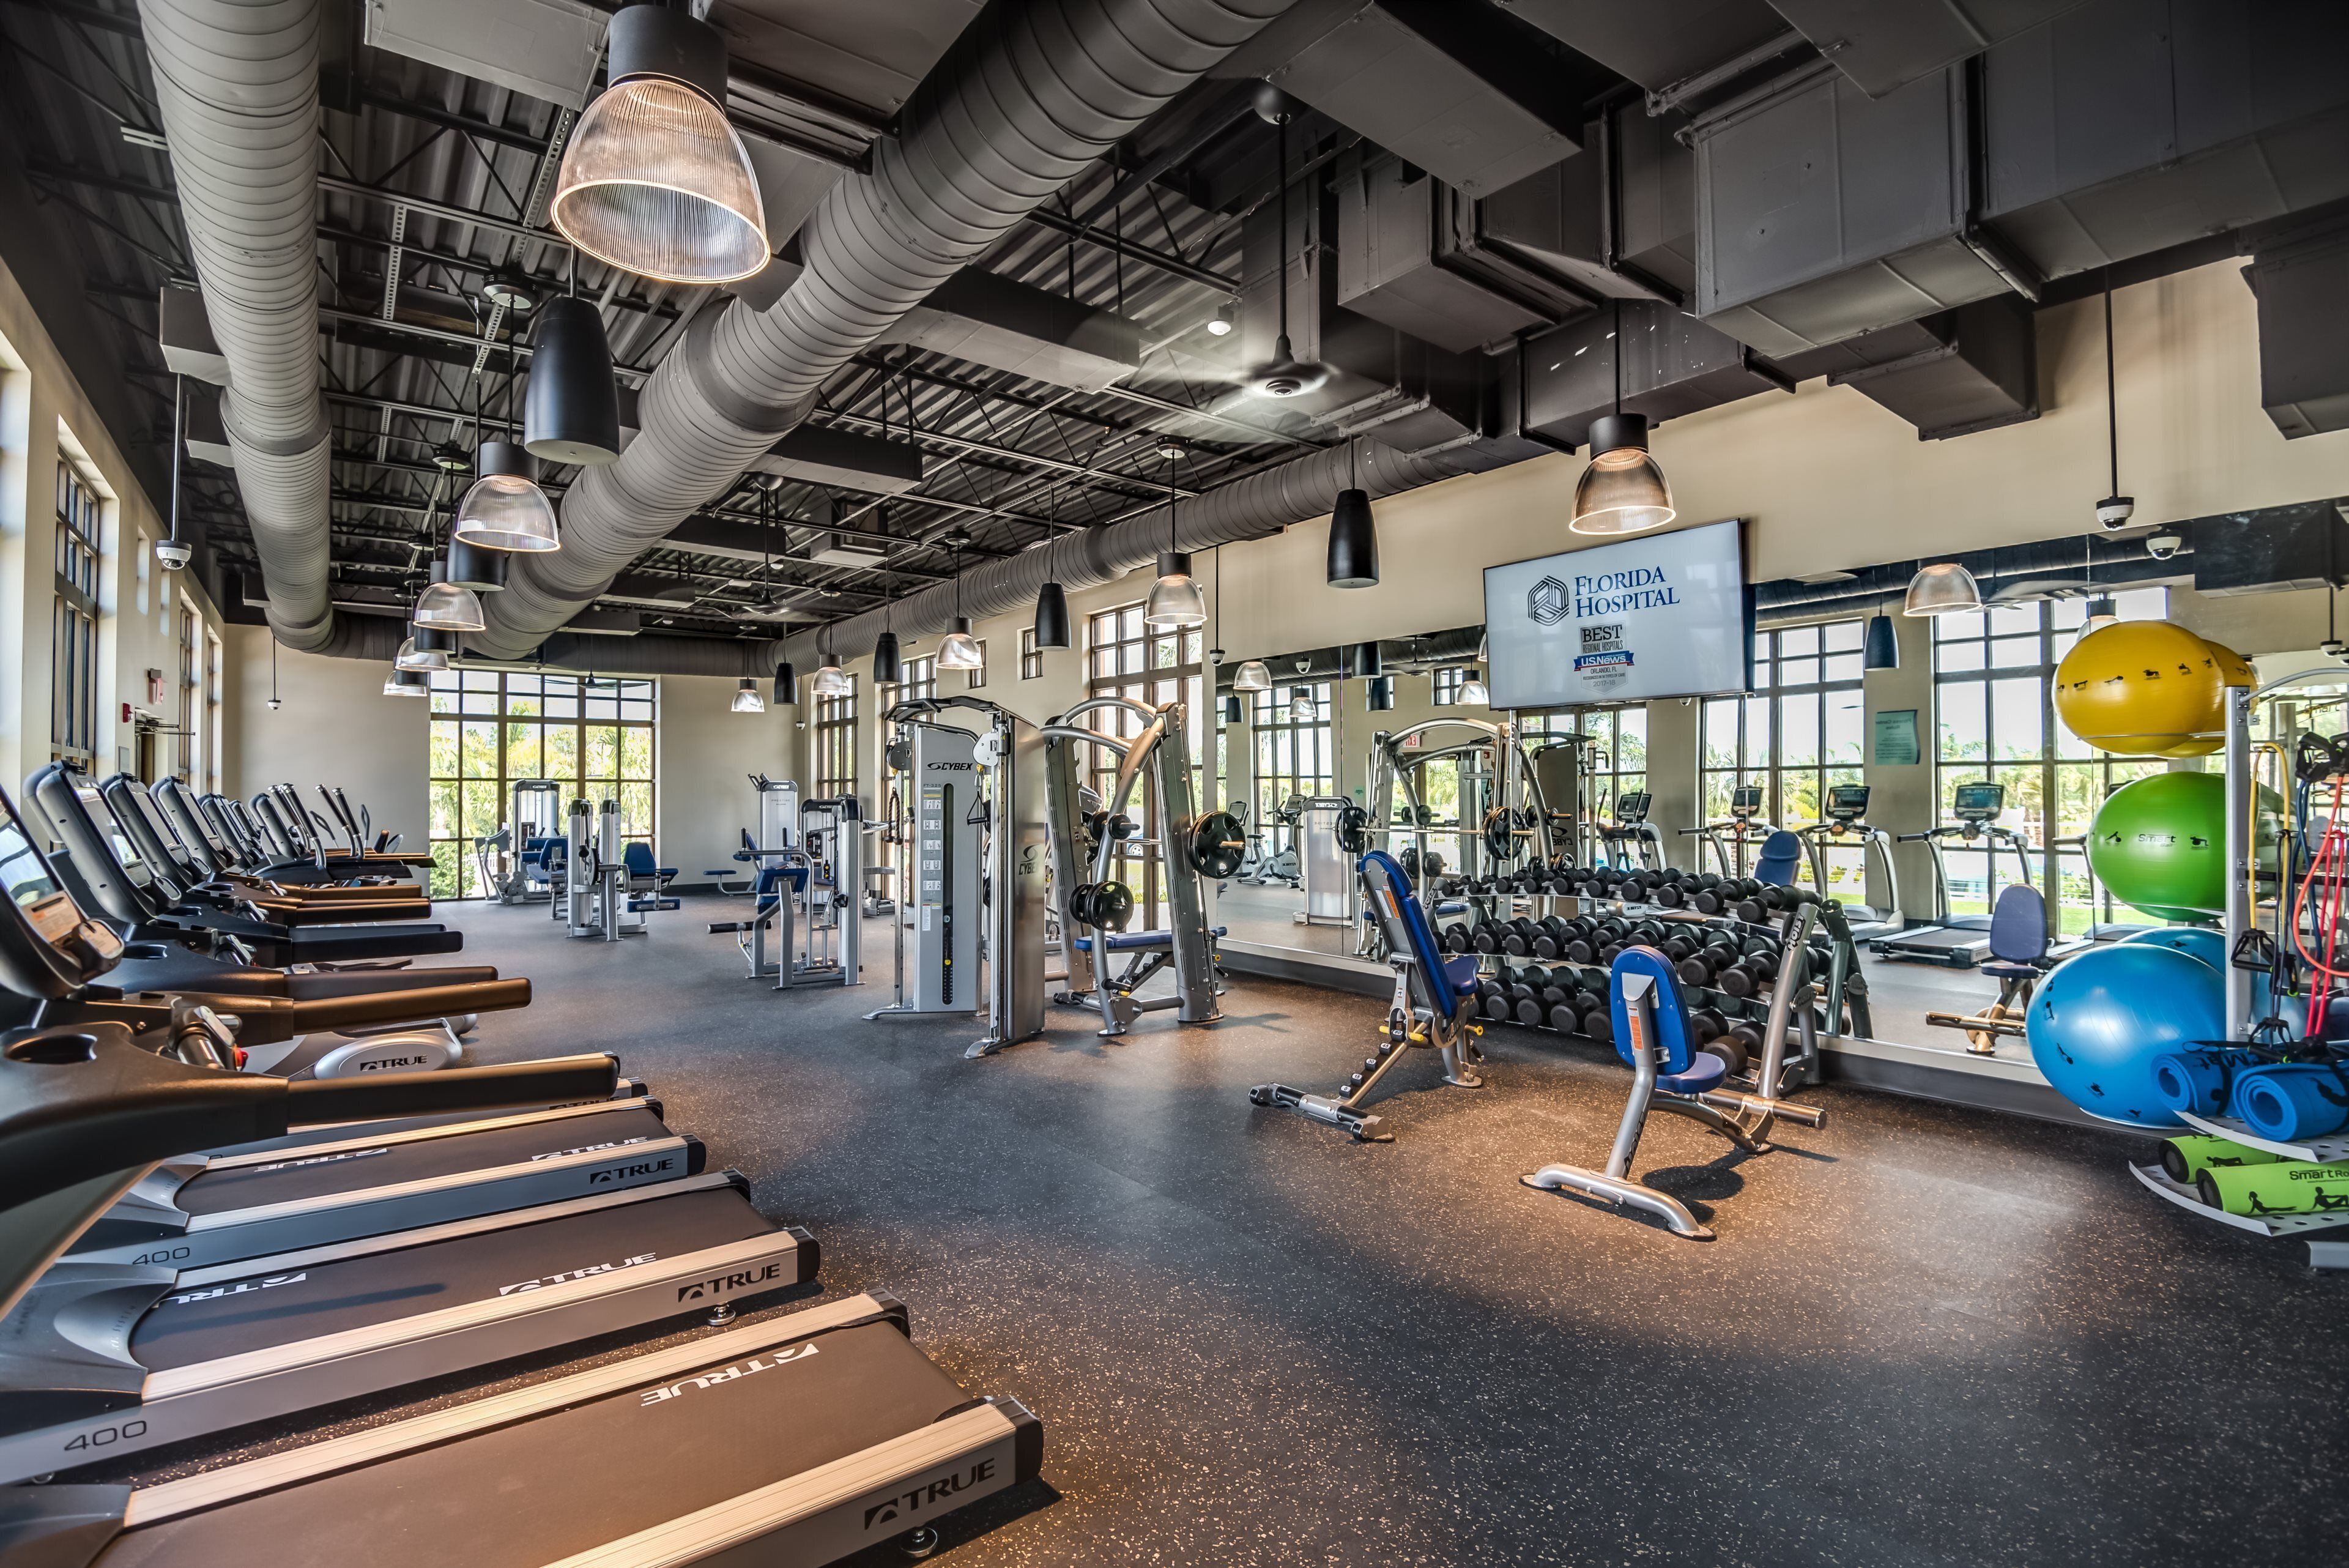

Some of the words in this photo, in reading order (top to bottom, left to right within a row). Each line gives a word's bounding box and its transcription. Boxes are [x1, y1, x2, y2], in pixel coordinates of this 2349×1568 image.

[1575, 566, 1666, 596] FLORIDA
[1575, 587, 1680, 618] HOSPITAL
[1582, 624, 1623, 643] BEST
[1583, 642, 1601, 654] REGIONAL
[1602, 639, 1623, 652] HOSPITALS
[2139, 834, 2176, 842] Smart
[378, 1055, 427, 1068] TRUE
[563, 1136, 647, 1154] TRUE
[614, 1159, 674, 1178] TRUE
[2289, 1169, 2334, 1181] Smart
[132, 1247, 190, 1265] 400
[543, 1252, 656, 1284] TRUE
[707, 1263, 780, 1294] TRUE
[153, 1284, 258, 1307] TRU
[640, 1360, 776, 1406] TRUE
[64, 1421, 147, 1451] 400
[902, 1457, 995, 1511] TRUE
